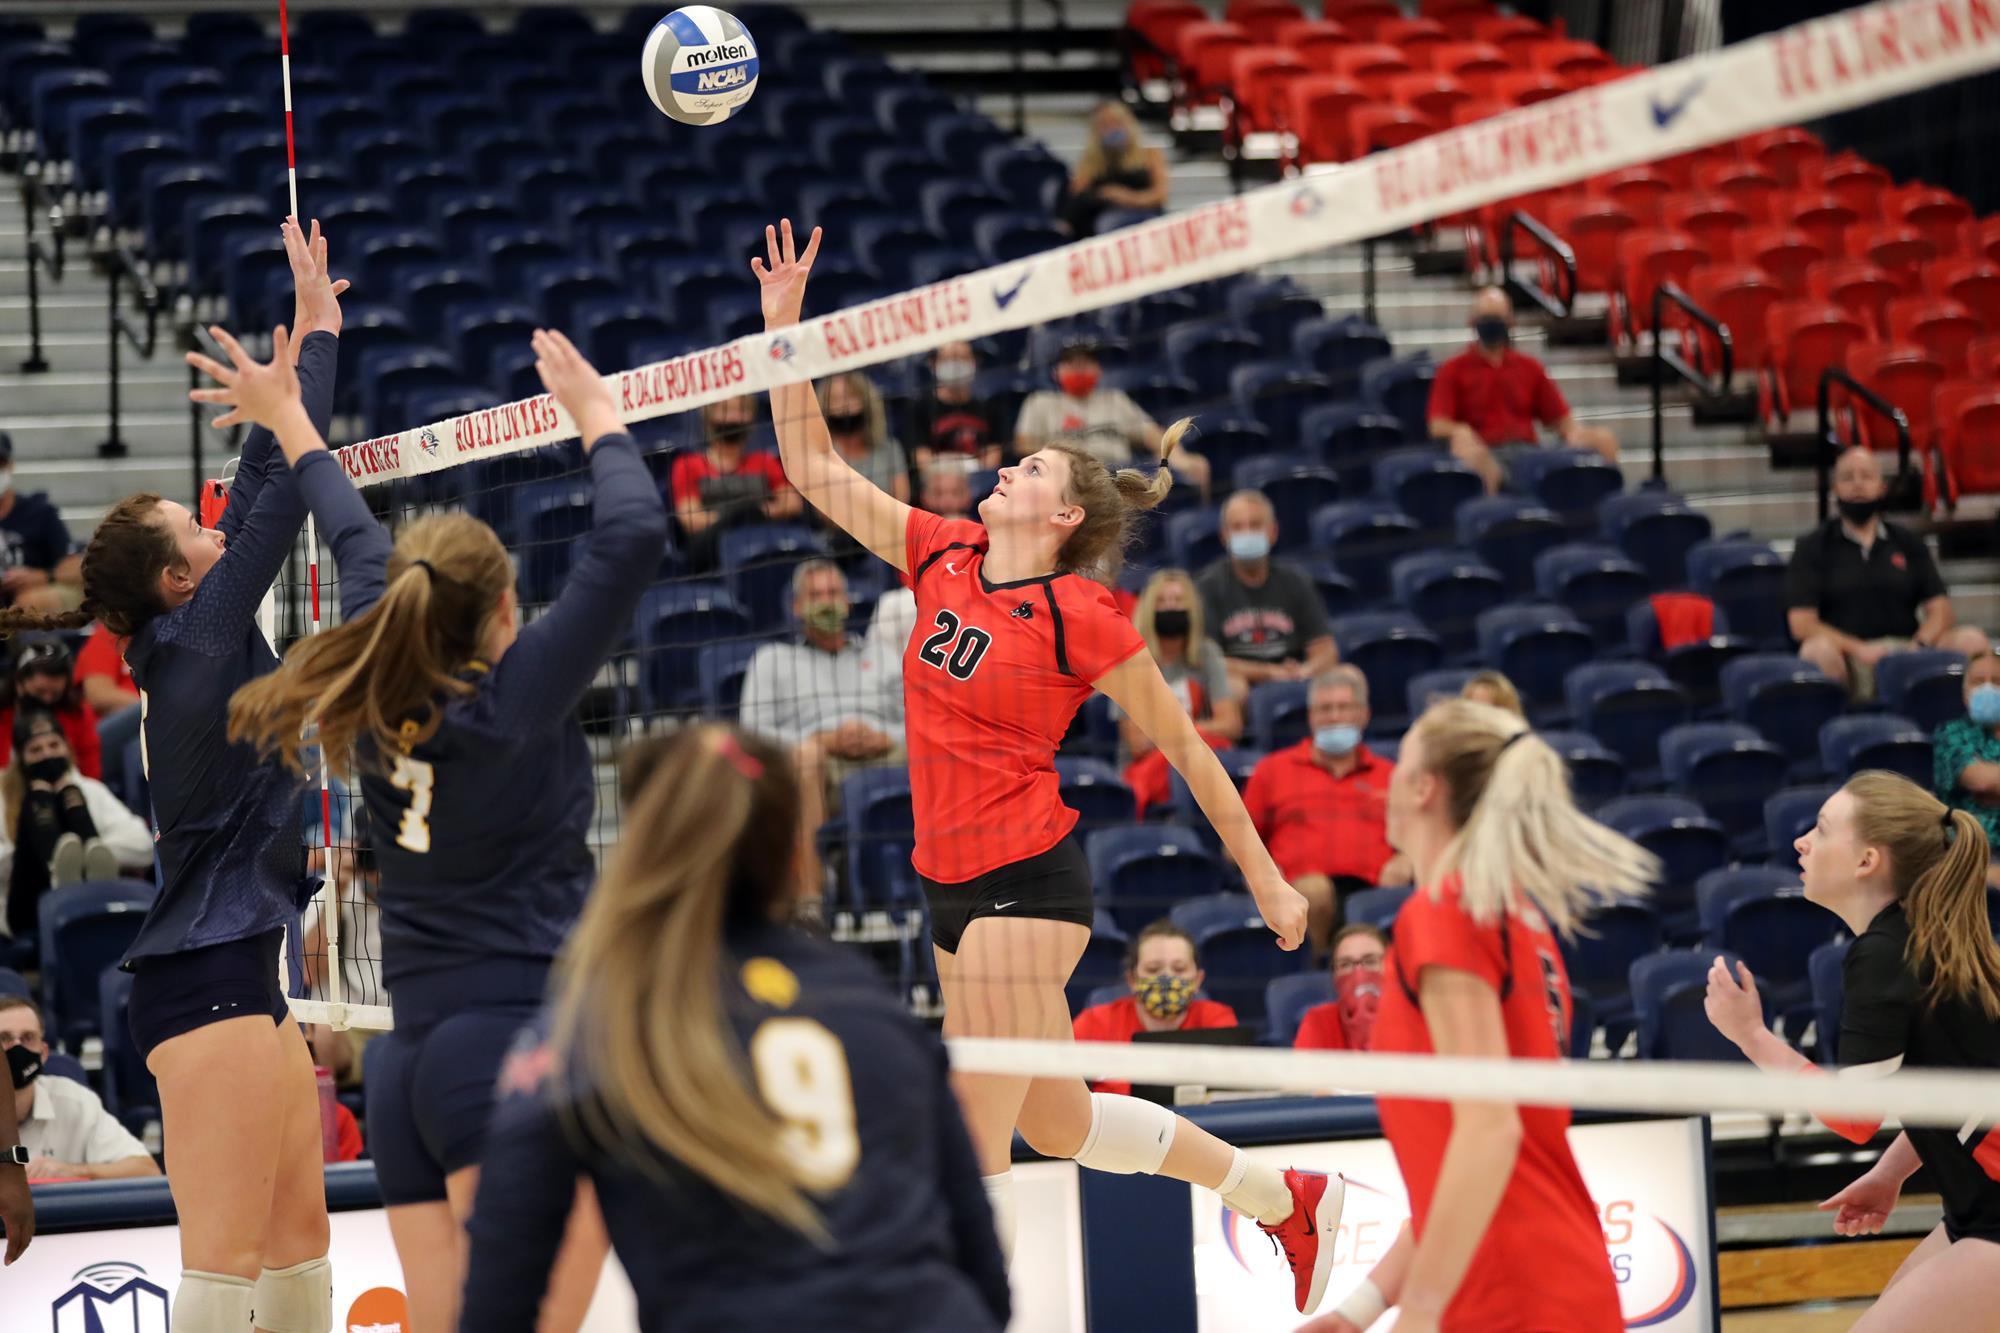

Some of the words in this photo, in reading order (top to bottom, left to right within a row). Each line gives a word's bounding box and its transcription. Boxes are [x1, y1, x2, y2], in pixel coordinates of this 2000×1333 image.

[687, 45, 748, 67] molten
[698, 64, 747, 91] NCAA
[918, 608, 993, 681] 20
[390, 755, 435, 853] 7
[752, 1016, 861, 1192] 9
